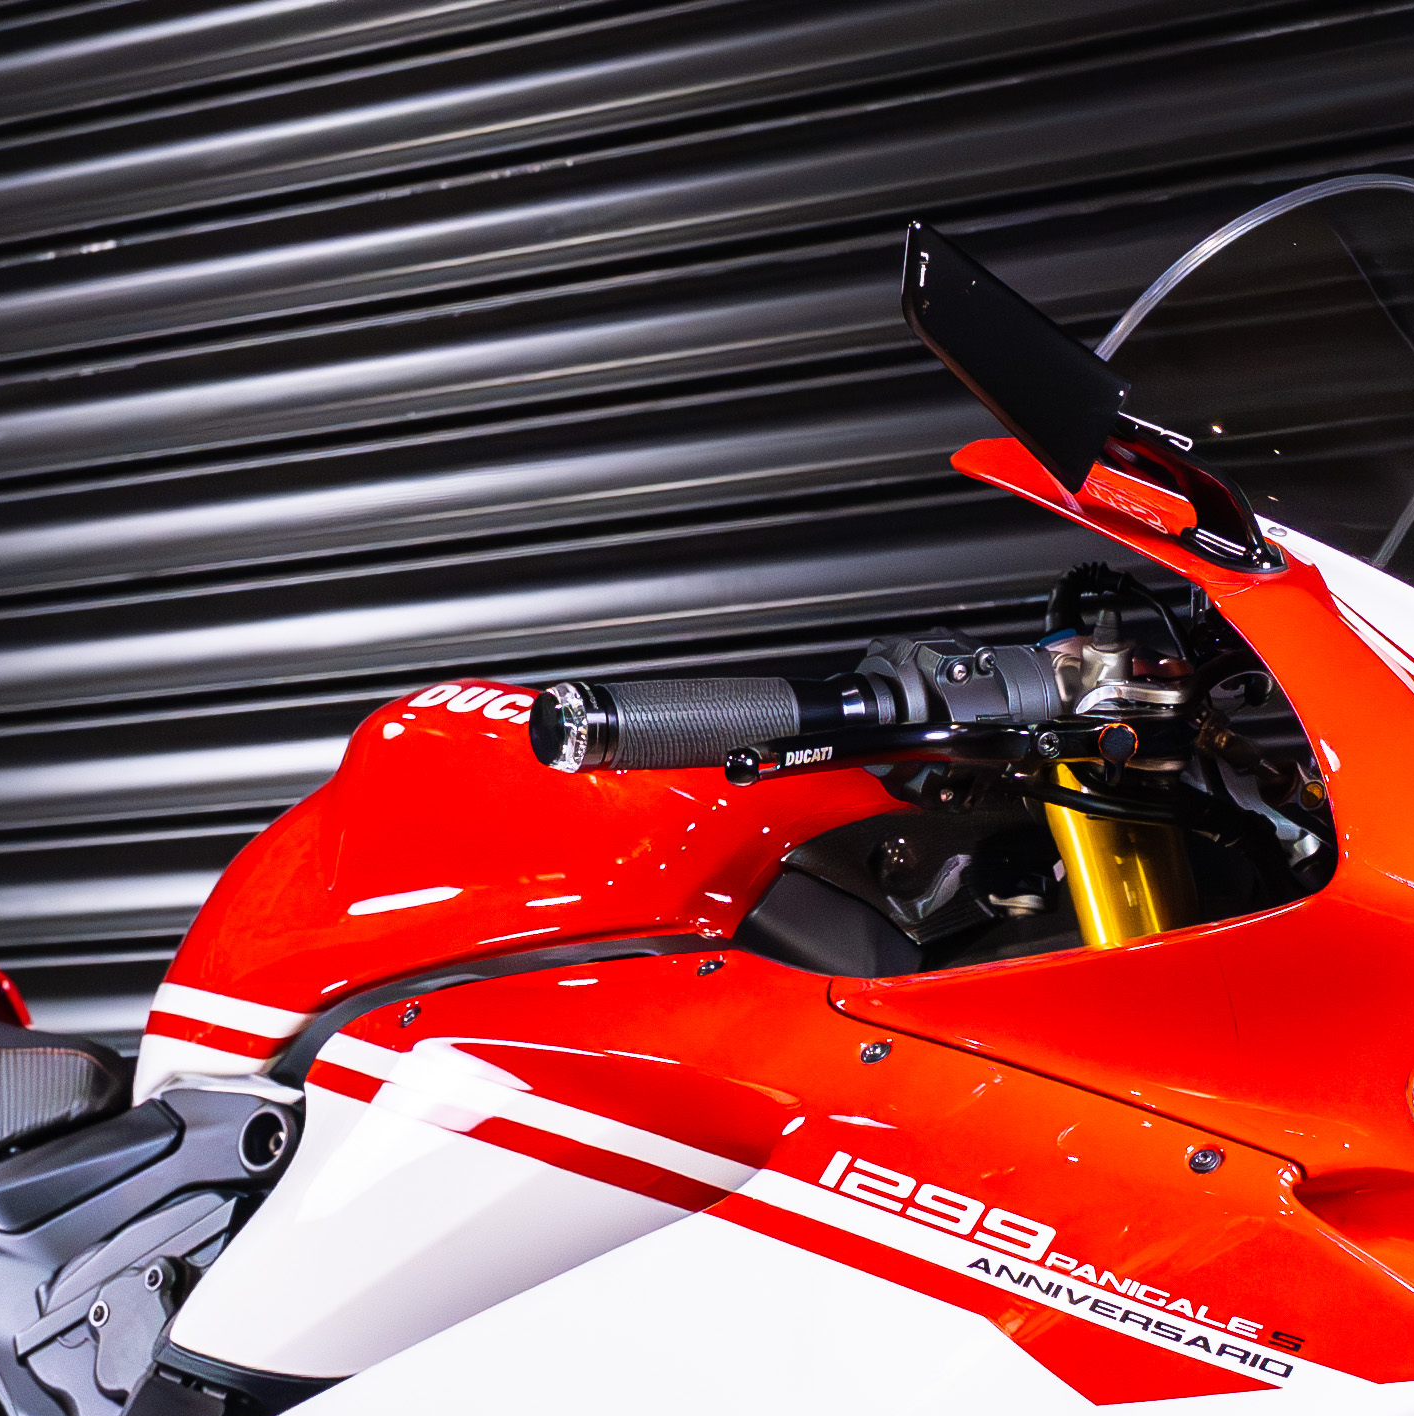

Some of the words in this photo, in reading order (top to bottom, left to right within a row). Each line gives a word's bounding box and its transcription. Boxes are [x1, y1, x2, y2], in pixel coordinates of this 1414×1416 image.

[784, 746, 833, 767] DUCATI
[818, 1151, 1057, 1263] 1299
[967, 1256, 1294, 1379] ANNIVERSARIO
[1044, 1249, 1264, 1340] PANIGALE
[1268, 1330, 1307, 1353] S
